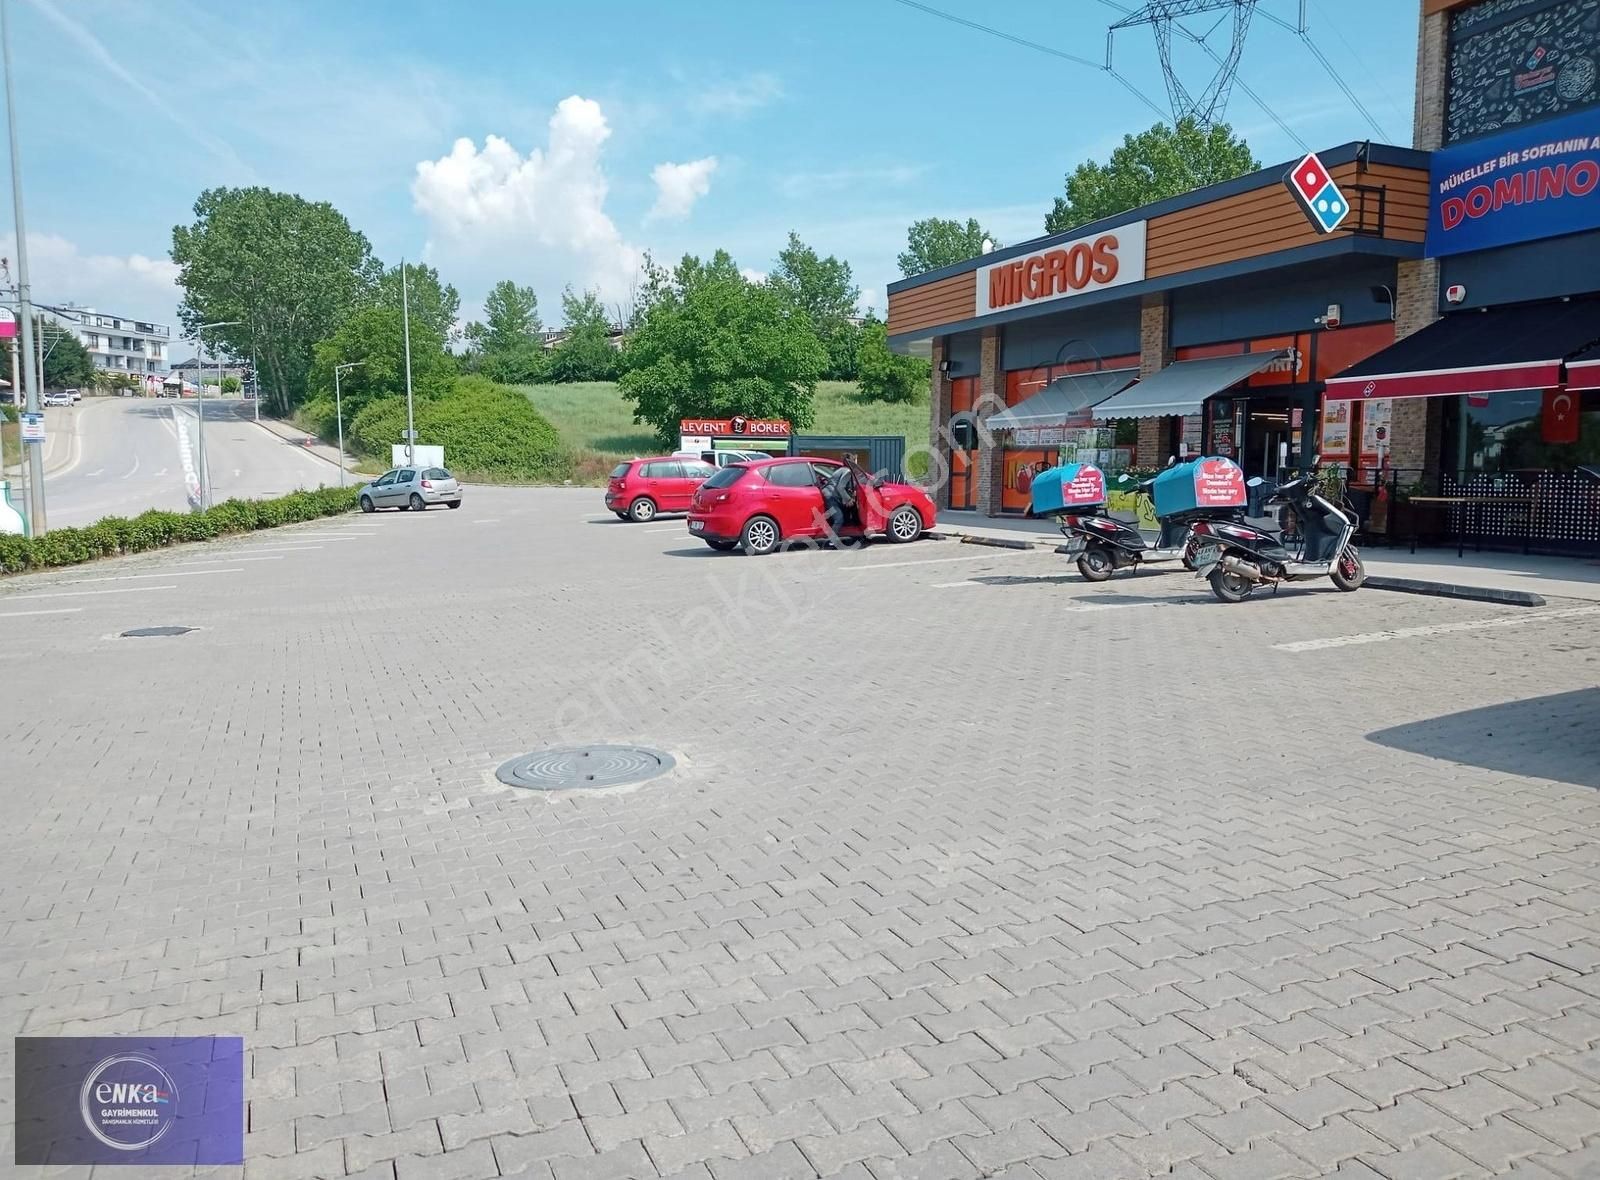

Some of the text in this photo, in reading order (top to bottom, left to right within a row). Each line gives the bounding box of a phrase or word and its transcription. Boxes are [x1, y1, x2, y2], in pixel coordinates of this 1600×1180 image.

[1439, 158, 1497, 194] MÜKELLEF
[1499, 150, 1520, 170] BİR
[1521, 138, 1588, 161] SOFRANIN
[682, 422, 726, 432] LEVENT
[750, 420, 789, 433] BÖREK
